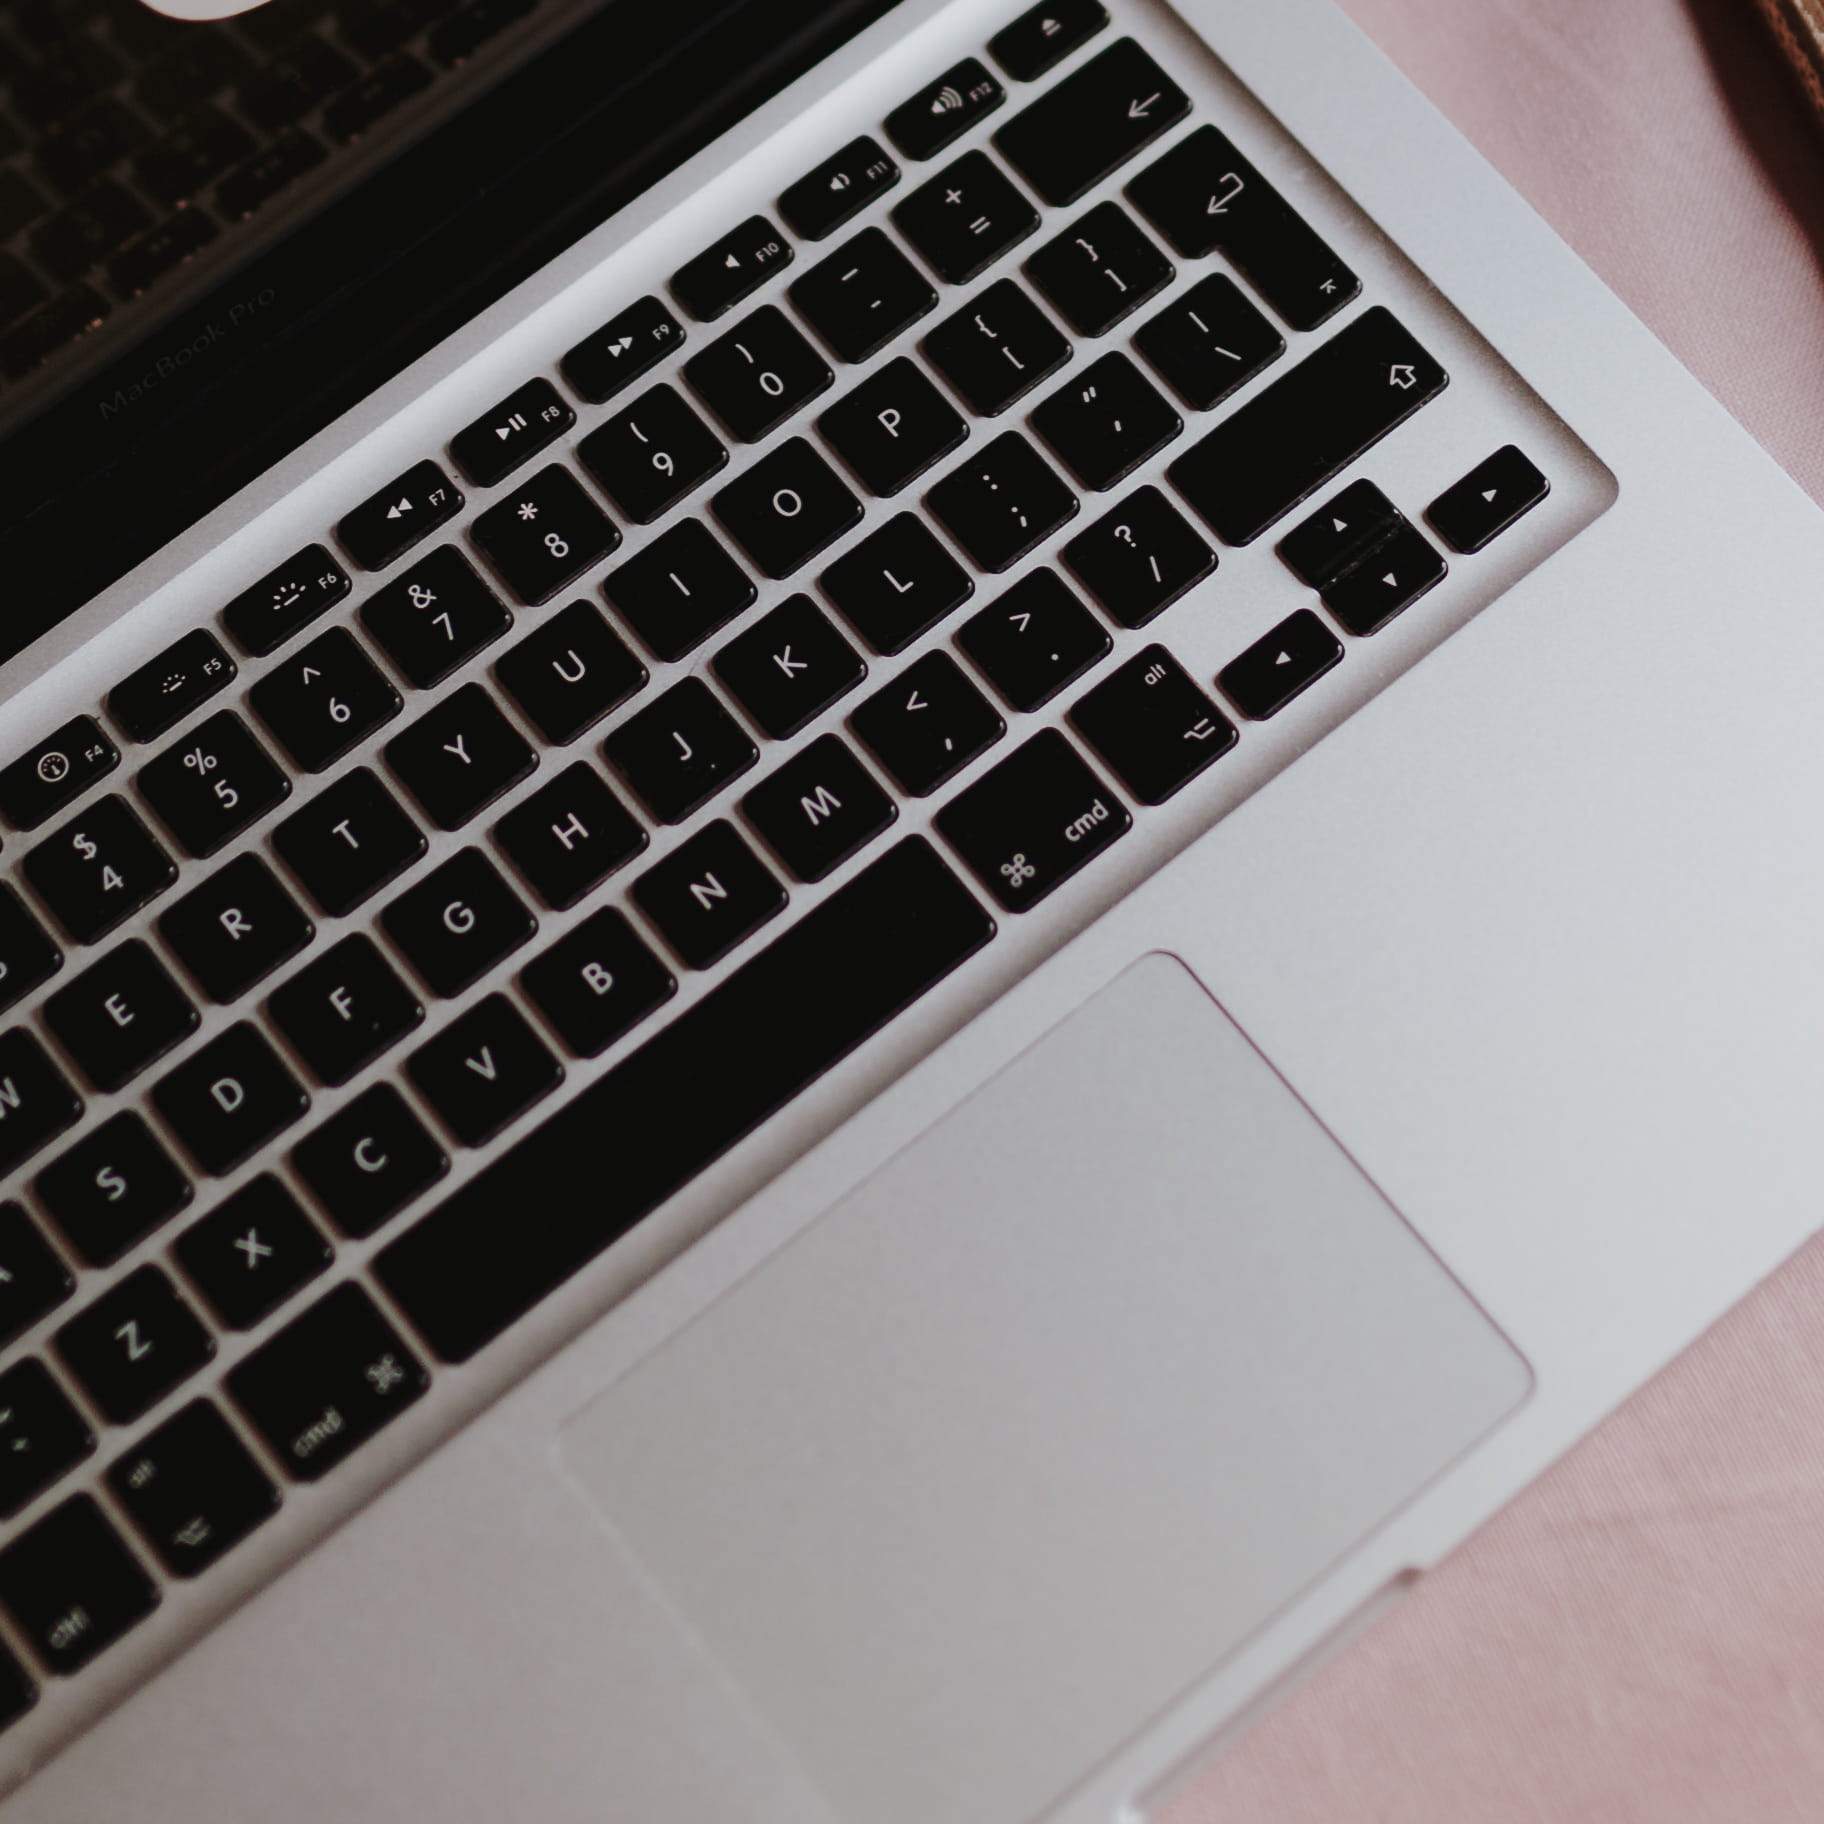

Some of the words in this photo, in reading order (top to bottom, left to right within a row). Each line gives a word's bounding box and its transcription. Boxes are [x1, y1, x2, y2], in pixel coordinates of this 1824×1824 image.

[945, 188, 962, 204] +
[754, 242, 780, 263] F10
[651, 323, 670, 341] F9
[97, 323, 225, 422] MacBook
[228, 288, 276, 327] Pro
[759, 371, 784, 396] 0
[540, 405, 561, 423] F8
[877, 408, 901, 438] P
[652, 451, 674, 477] 9
[428, 488, 446, 507] F7
[772, 488, 802, 517] O
[543, 532, 569, 558] 8
[1114, 524, 1137, 548] ?
[317, 572, 337, 590] F6
[669, 572, 691, 597] I
[883, 569, 914, 593] L
[407, 584, 438, 609] &
[431, 611, 454, 641] 7
[202, 657, 222, 676] F5
[552, 649, 586, 683] U
[772, 644, 808, 679] K
[1144, 663, 1167, 686] alt
[329, 696, 351, 723] 6
[84, 744, 104, 763] F4
[443, 734, 472, 764] Y
[672, 731, 693, 761] J
[183, 747, 218, 776] %
[213, 778, 239, 809] 5
[800, 785, 842, 826] M
[331, 819, 359, 849] T
[551, 812, 590, 851] H
[1064, 798, 1110, 842] cmd
[72, 833, 98, 860] $
[102, 865, 124, 891] 4
[689, 871, 728, 910] N
[219, 907, 253, 940] R
[442, 901, 475, 934] G
[581, 962, 614, 995] B
[104, 993, 135, 1027] E
[328, 986, 352, 1021] F
[465, 1045, 497, 1081] V
[210, 1077, 244, 1113] D
[353, 1137, 387, 1173] C
[95, 1166, 127, 1201] S
[234, 1228, 272, 1269] X
[115, 1320, 152, 1361] Z
